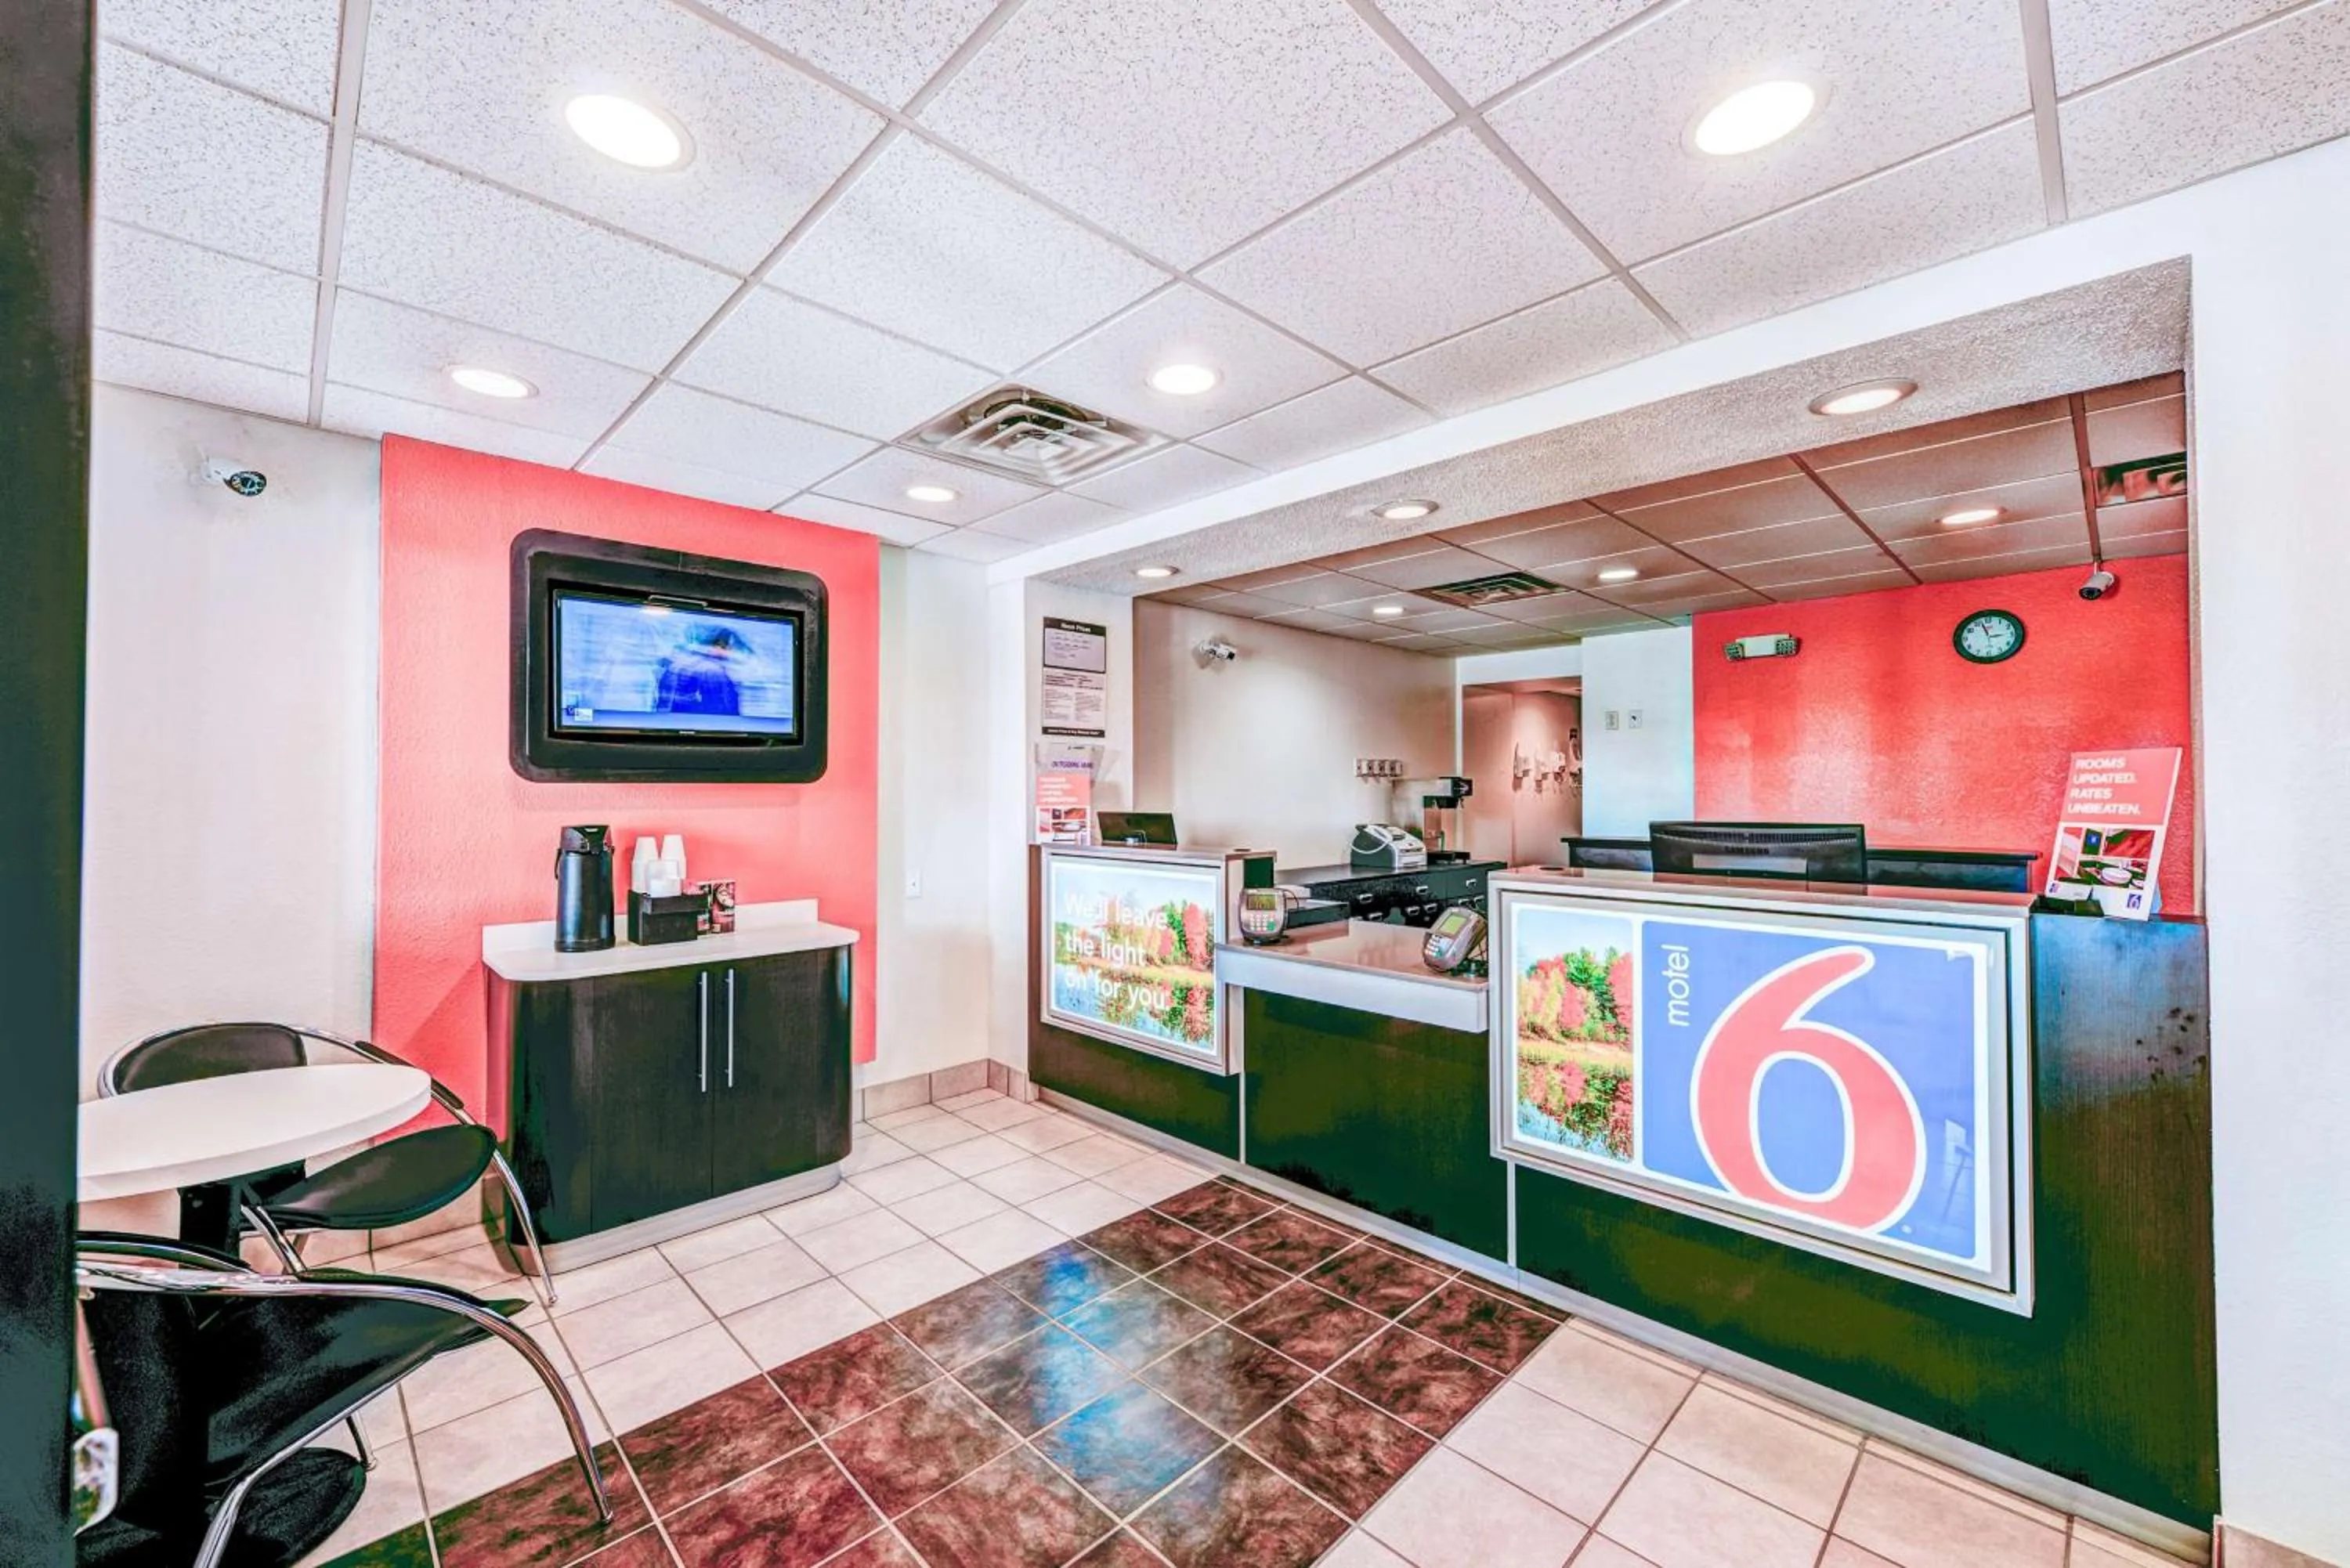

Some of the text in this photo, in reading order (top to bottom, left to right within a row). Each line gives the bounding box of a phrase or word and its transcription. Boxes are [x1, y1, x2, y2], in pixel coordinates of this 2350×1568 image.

[2075, 757, 2126, 769] ROOMS
[2073, 772, 2138, 784] UPDATED.
[2070, 787, 2113, 799] RATES
[2067, 803, 2141, 815] UNBEATEN.
[1115, 896, 1167, 930] leave
[1065, 927, 1147, 967] the light
[1065, 971, 1087, 990] on
[1088, 969, 1122, 997] for
[1661, 944, 1690, 1027] motel
[1690, 945, 1927, 1234] 6
